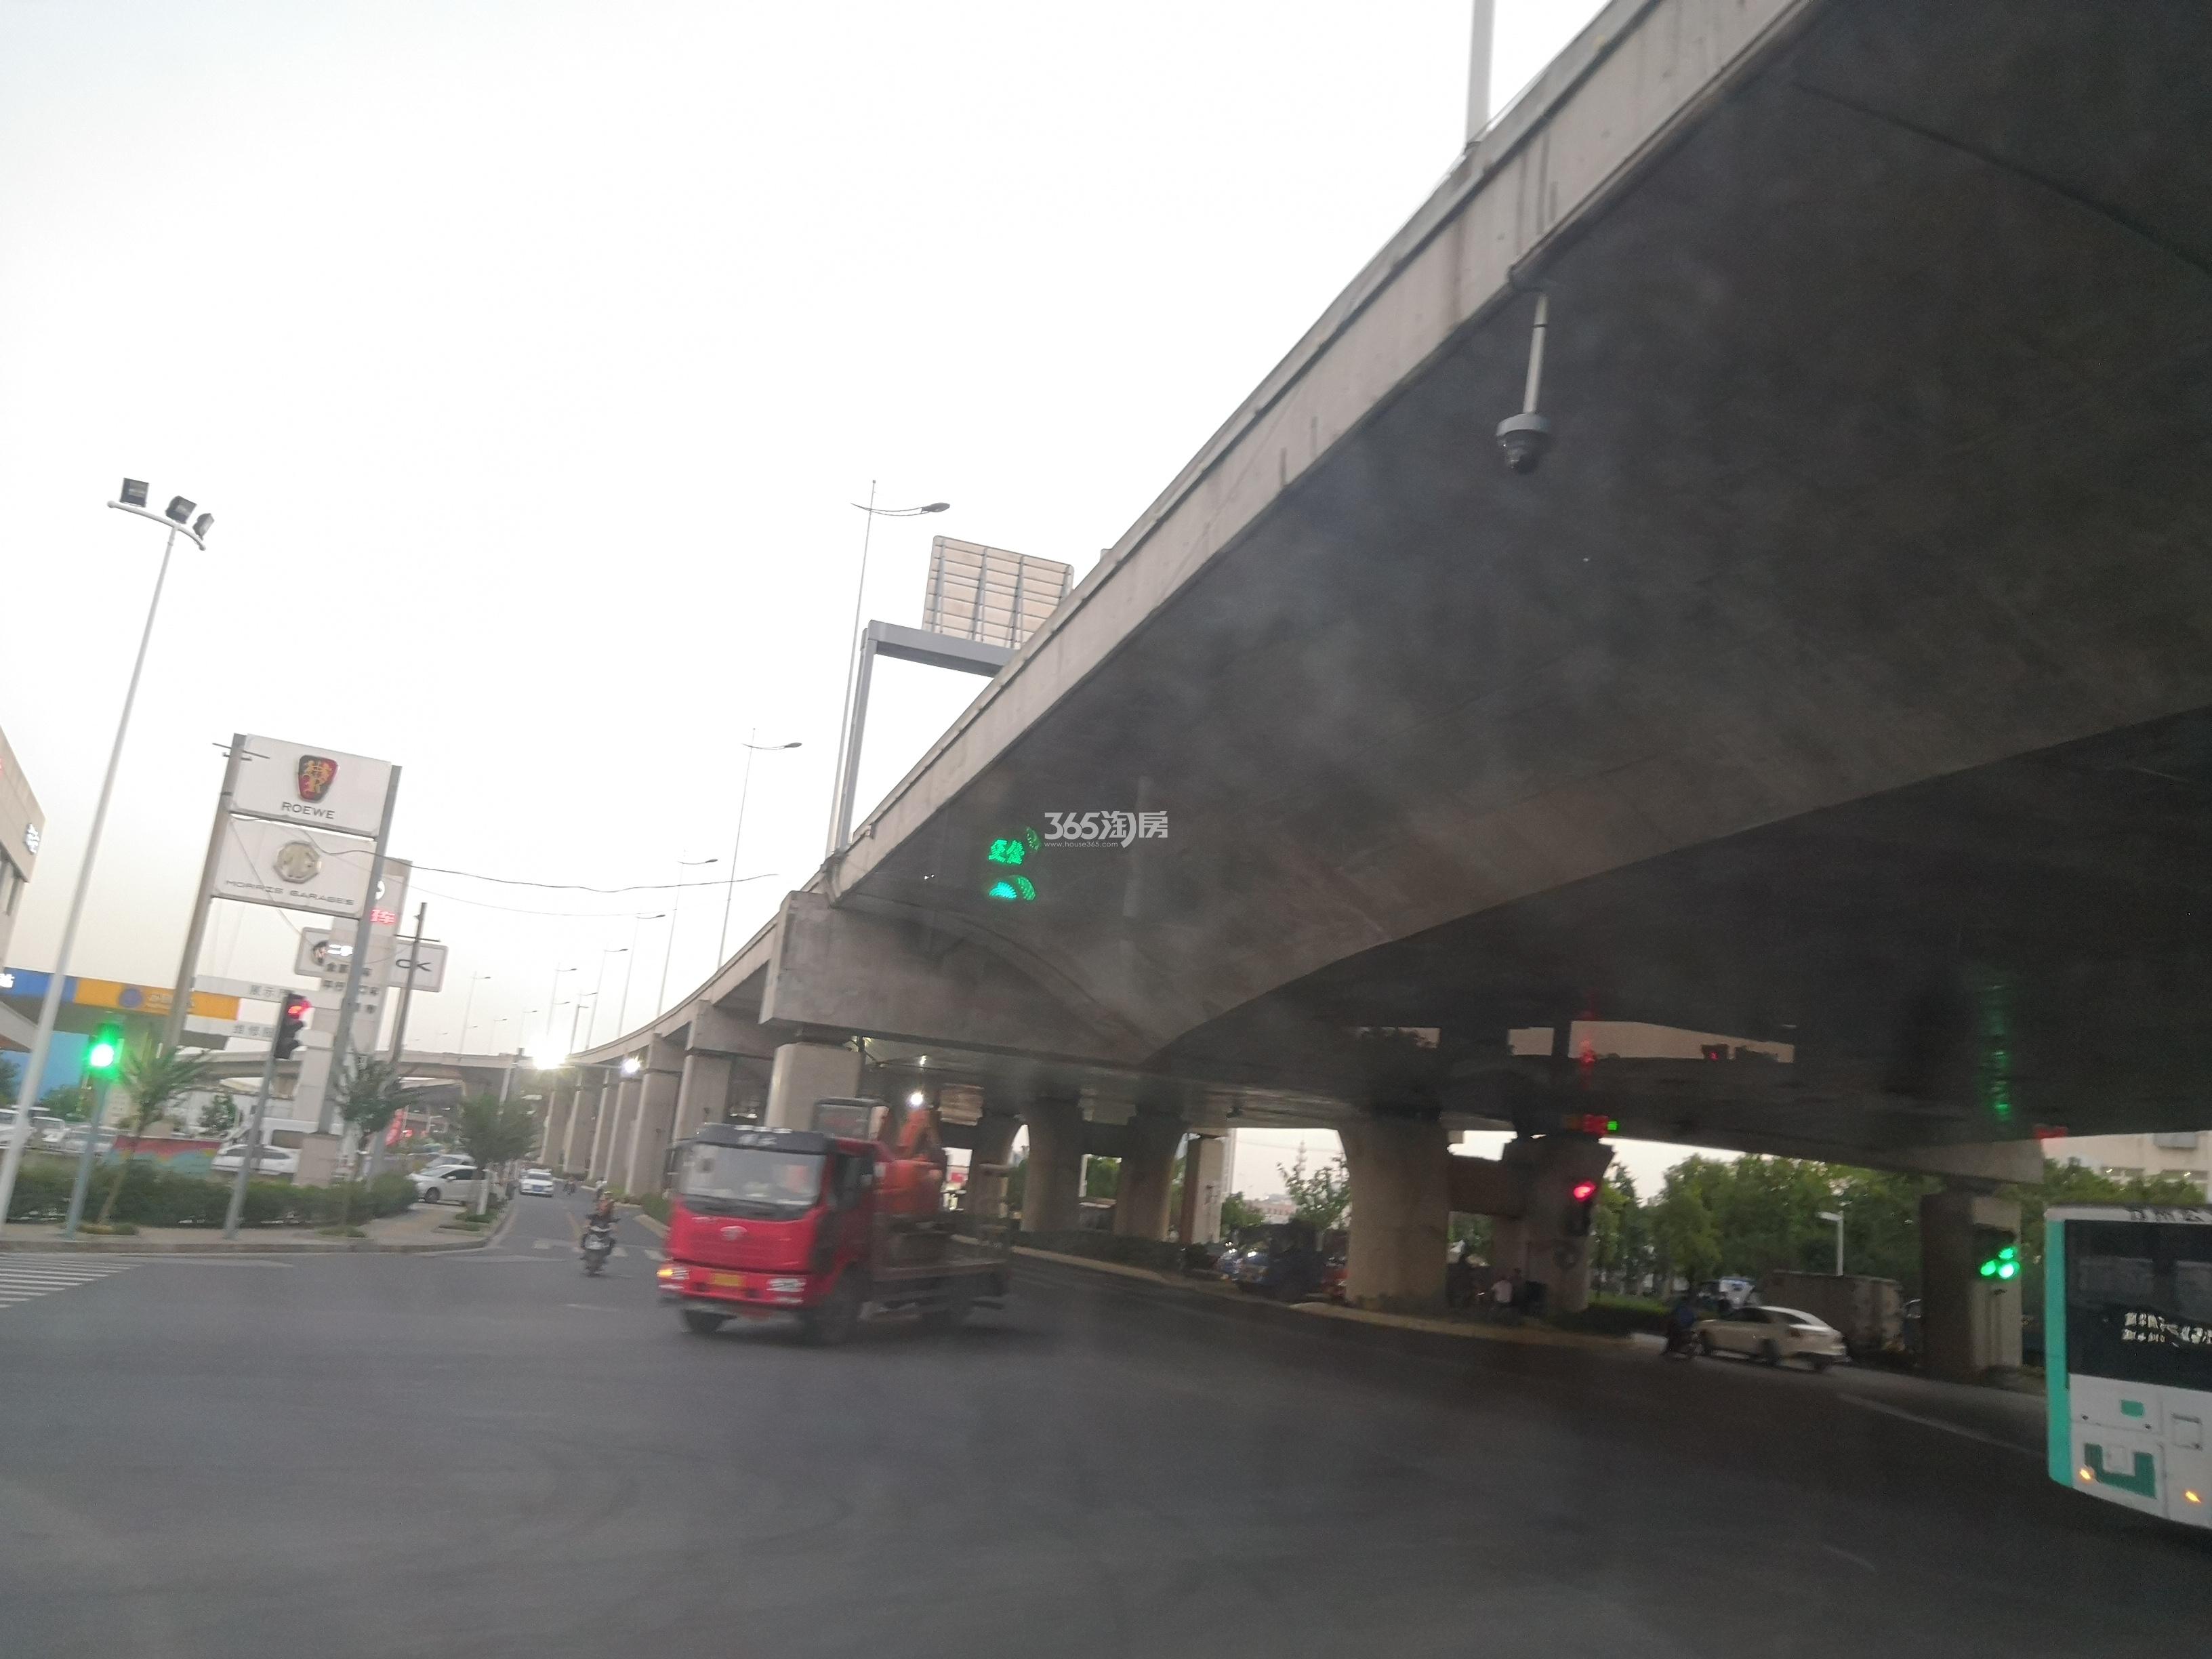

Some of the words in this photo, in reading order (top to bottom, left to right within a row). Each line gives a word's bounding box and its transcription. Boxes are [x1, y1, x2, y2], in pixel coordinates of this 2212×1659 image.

[281, 802, 335, 819] ROEWE
[226, 880, 284, 894] MORRIS
[290, 890, 355, 905] GARAGES
